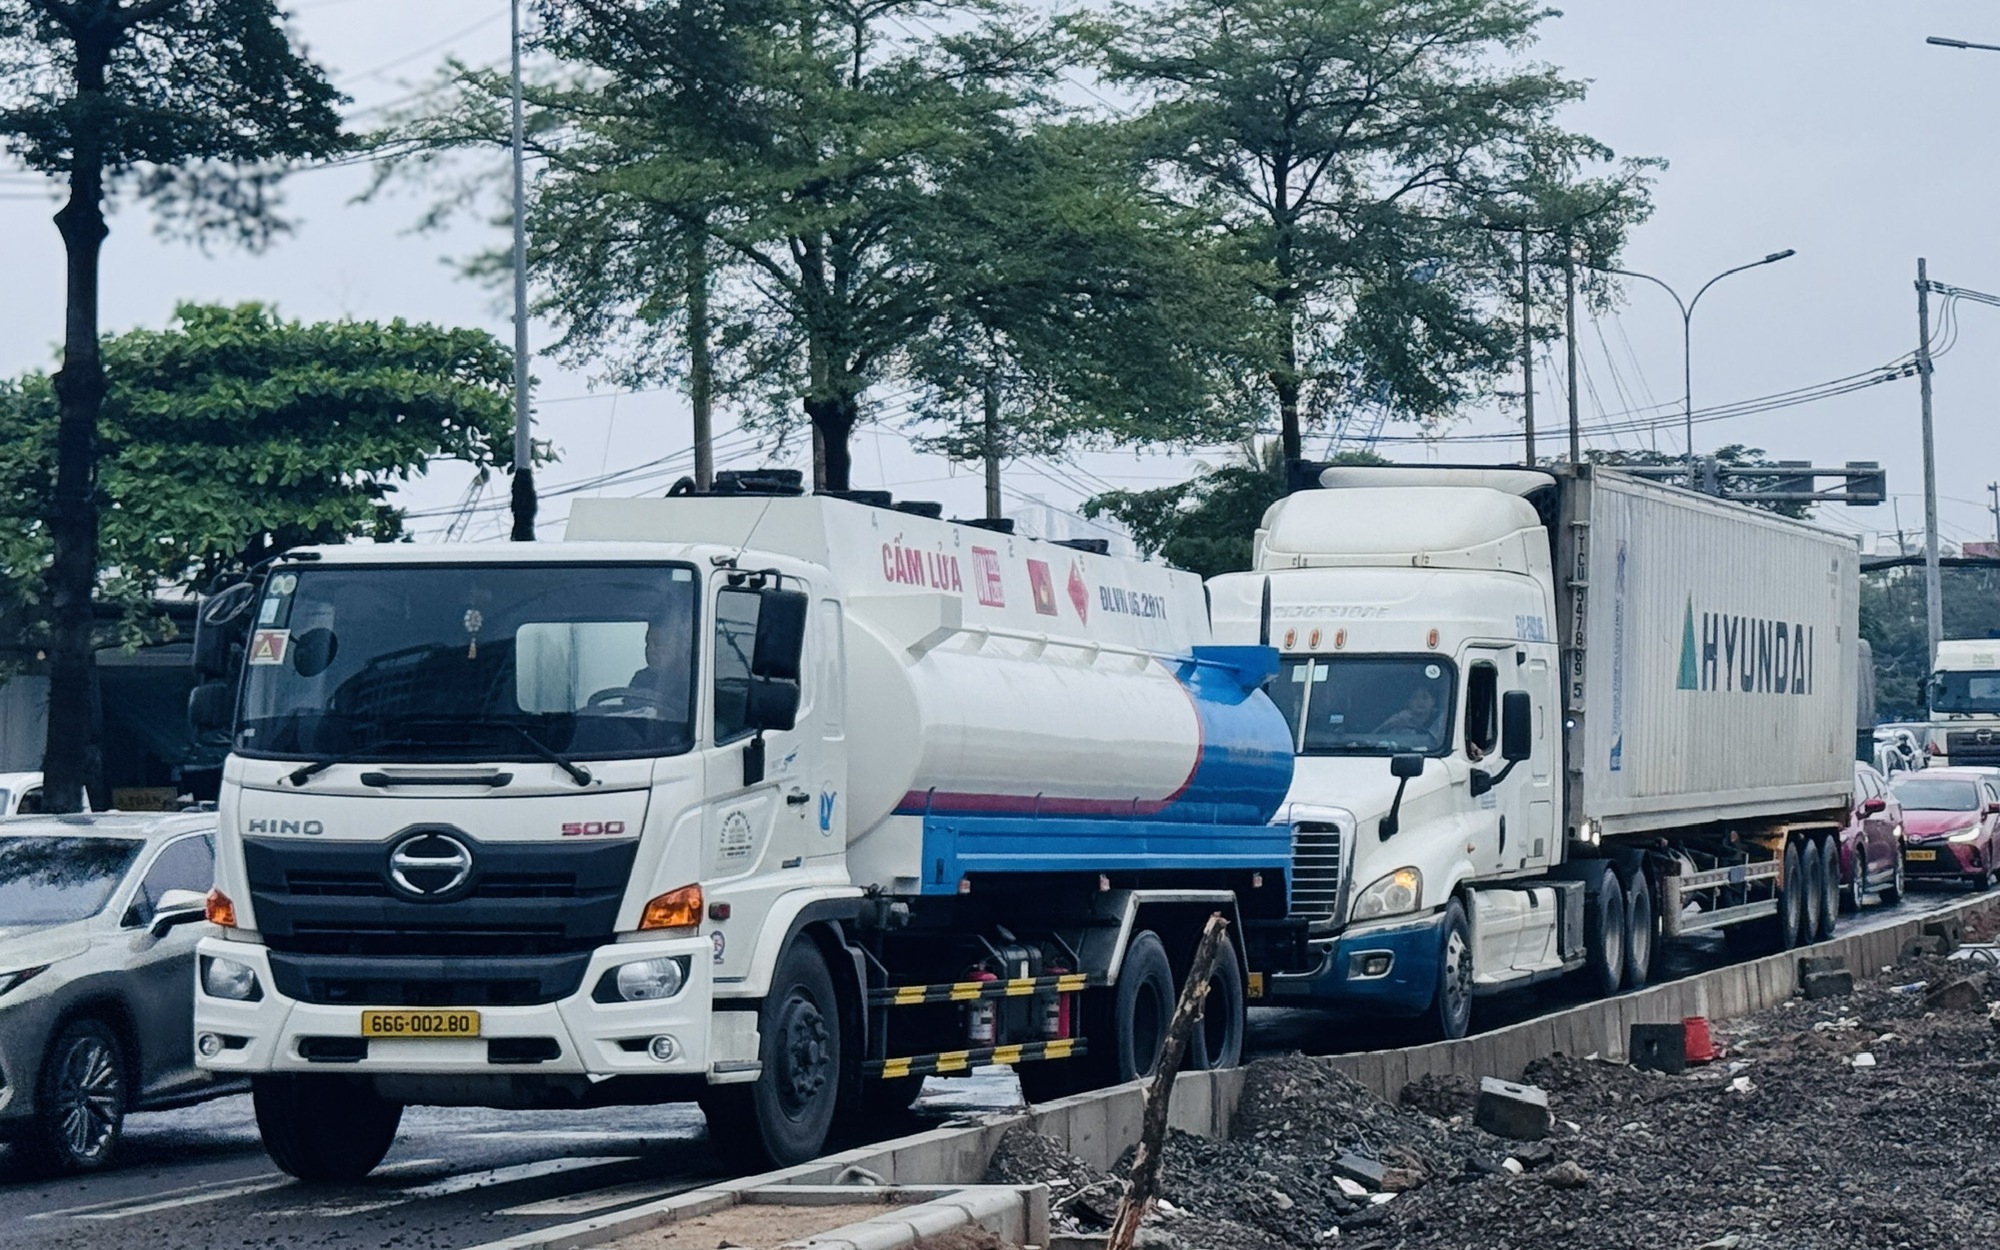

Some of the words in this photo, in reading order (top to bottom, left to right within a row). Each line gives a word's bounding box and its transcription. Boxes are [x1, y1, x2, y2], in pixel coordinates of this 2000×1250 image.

[882, 532, 926, 587] CẤM
[927, 541, 964, 593] LỬA
[1702, 611, 1813, 695] HYUNDAI
[249, 819, 324, 835] HINO
[561, 821, 625, 836] 500
[371, 1015, 470, 1033] 66G-002.80
